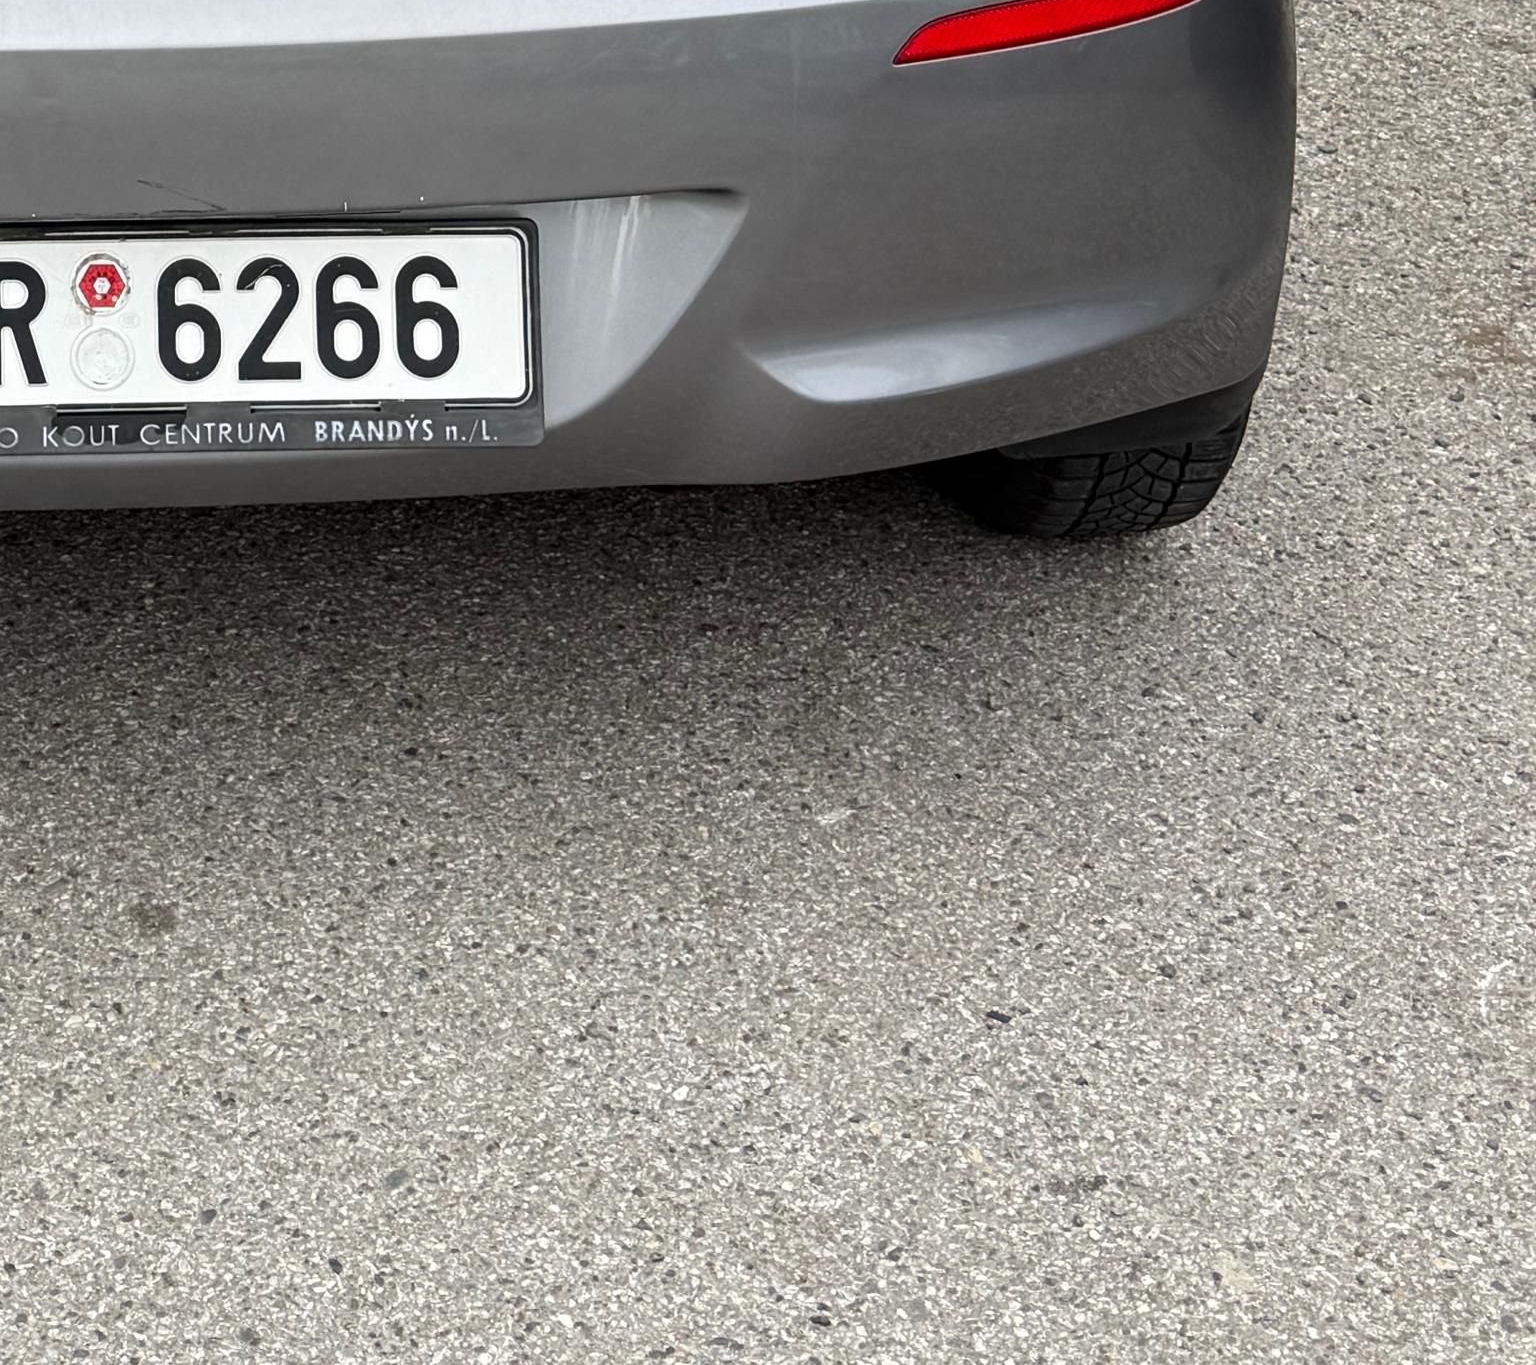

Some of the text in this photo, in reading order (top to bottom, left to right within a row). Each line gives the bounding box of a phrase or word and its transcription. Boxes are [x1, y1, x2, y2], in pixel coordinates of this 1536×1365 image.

[157, 255, 460, 383] 6266
[42, 423, 120, 448] KOUT
[139, 421, 286, 446] CENTRUM
[314, 414, 434, 443] BRANDÝS
